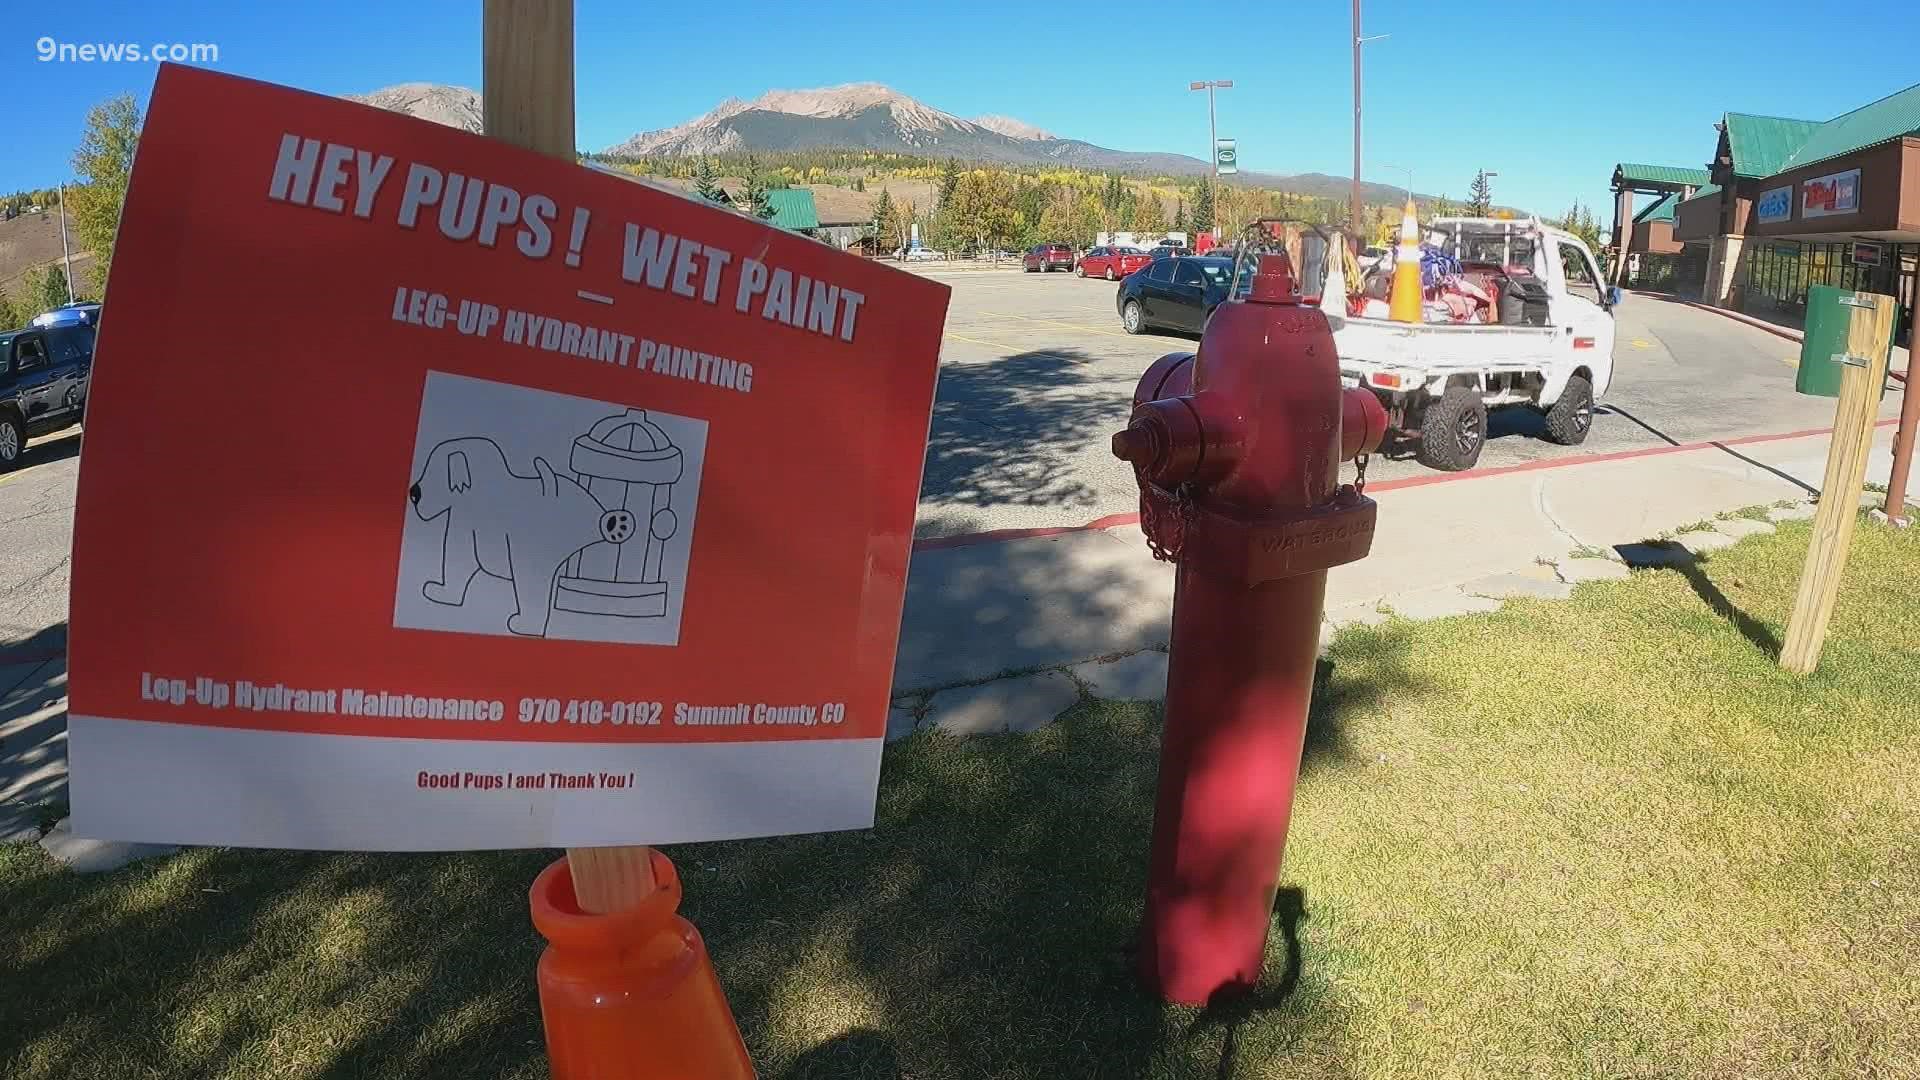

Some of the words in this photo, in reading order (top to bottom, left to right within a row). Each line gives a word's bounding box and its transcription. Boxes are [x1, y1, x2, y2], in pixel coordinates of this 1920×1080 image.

[269, 133, 394, 219] HEY
[735, 257, 865, 342] PAINT
[392, 287, 498, 338] LEG-UP
[503, 309, 636, 367] HYDRANT
[637, 339, 753, 393] PAINTING
[141, 672, 230, 709] Leg-Up
[235, 680, 337, 713] Hydrant
[341, 688, 505, 721] Maintenance
[518, 698, 561, 724] 970
[564, 700, 663, 726] 418-0192
[674, 702, 751, 726] Summit
[753, 702, 818, 727] County,
[820, 702, 846, 724] CO
[417, 770, 460, 789] Good
[516, 772, 545, 789] and
[549, 773, 596, 789] Thank
